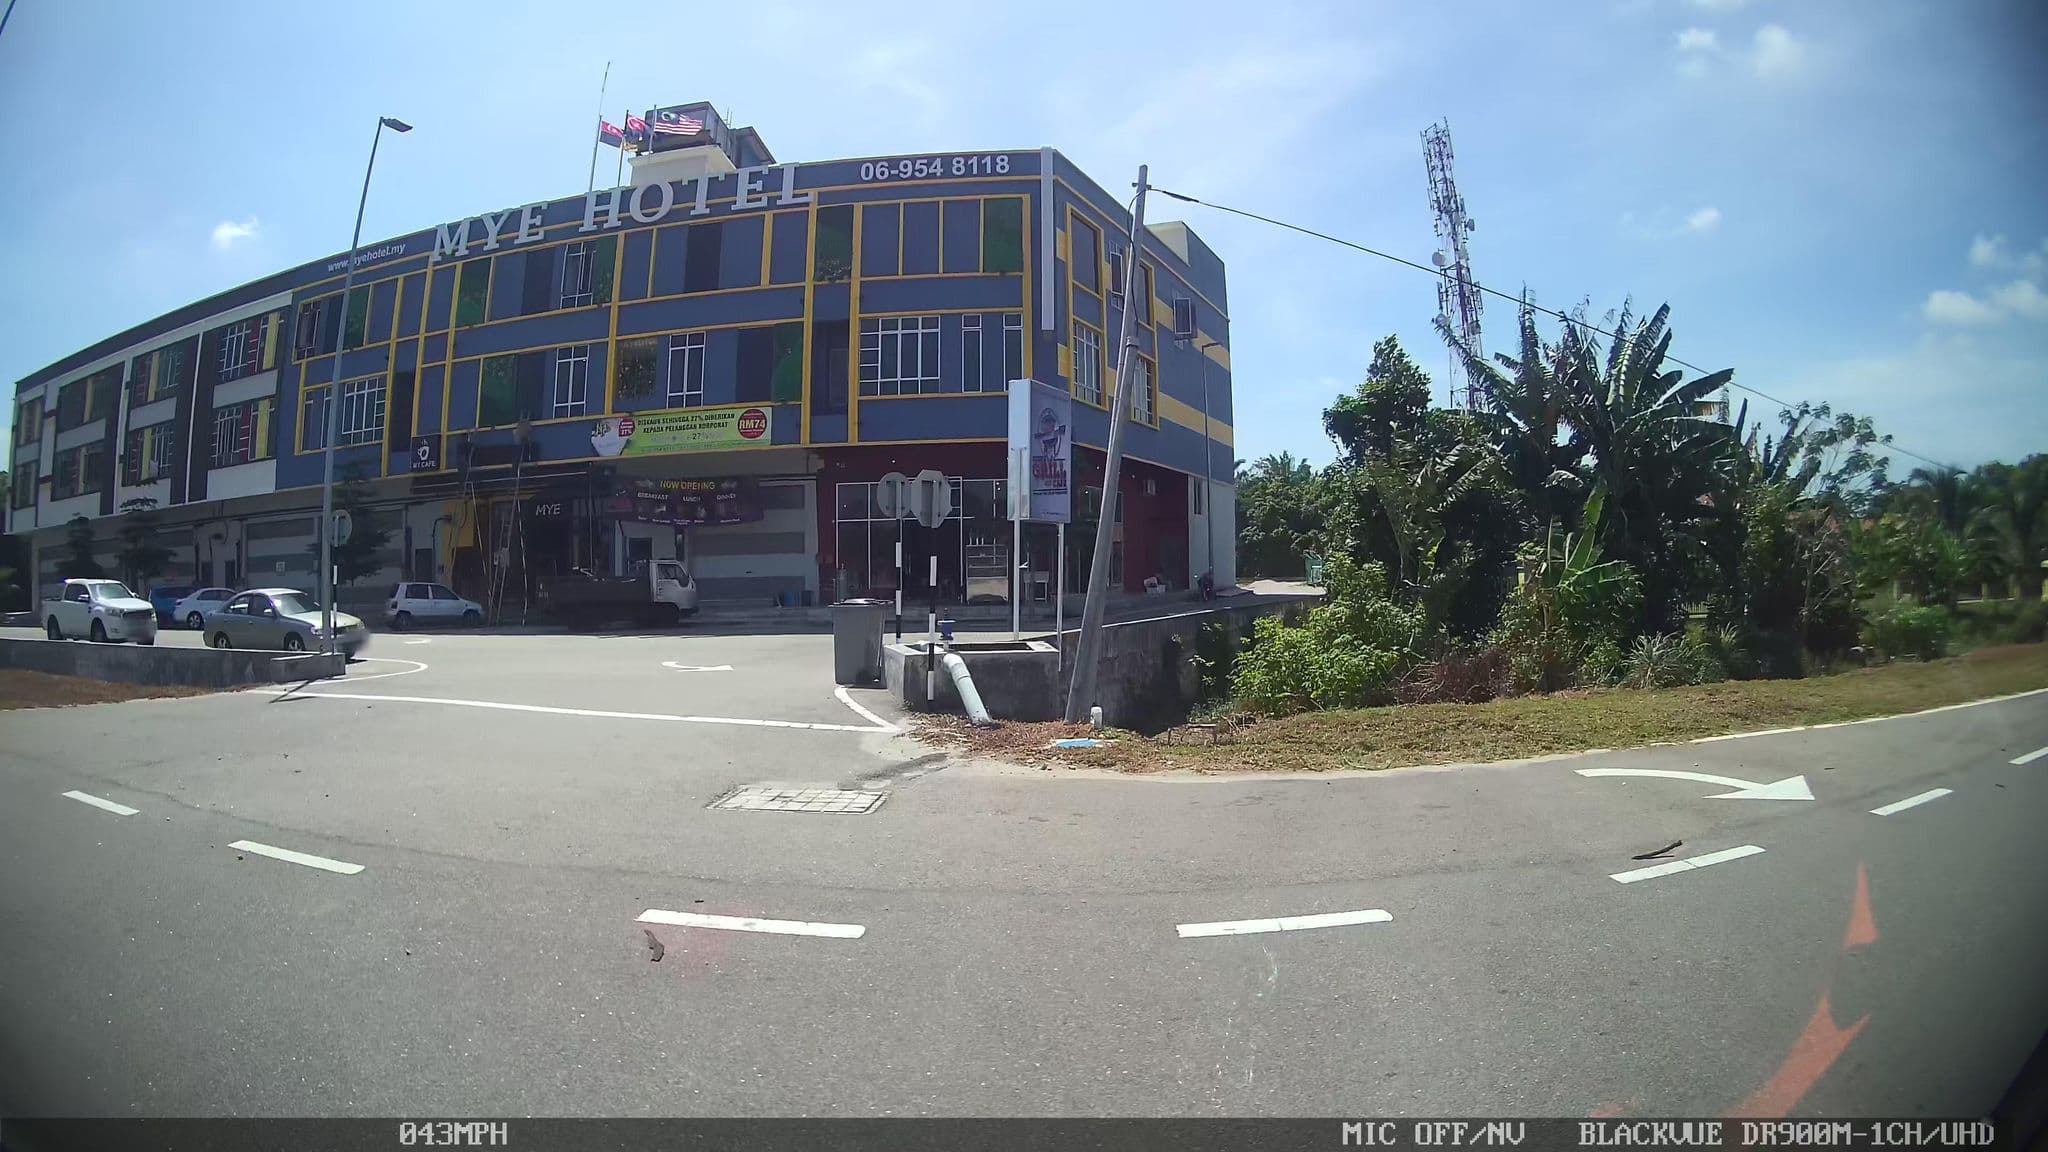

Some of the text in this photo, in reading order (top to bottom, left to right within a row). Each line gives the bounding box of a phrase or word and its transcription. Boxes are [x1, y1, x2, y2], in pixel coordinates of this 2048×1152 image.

[860, 154, 1010, 181] 06-954 8118
[432, 162, 814, 262] MYE HOTEL
[704, 412, 735, 422] DIBERIKAN
[739, 418, 767, 429] RM74
[421, 460, 436, 468] CAFE
[660, 480, 716, 490] NOW OPENING
[535, 503, 561, 516] MYE
